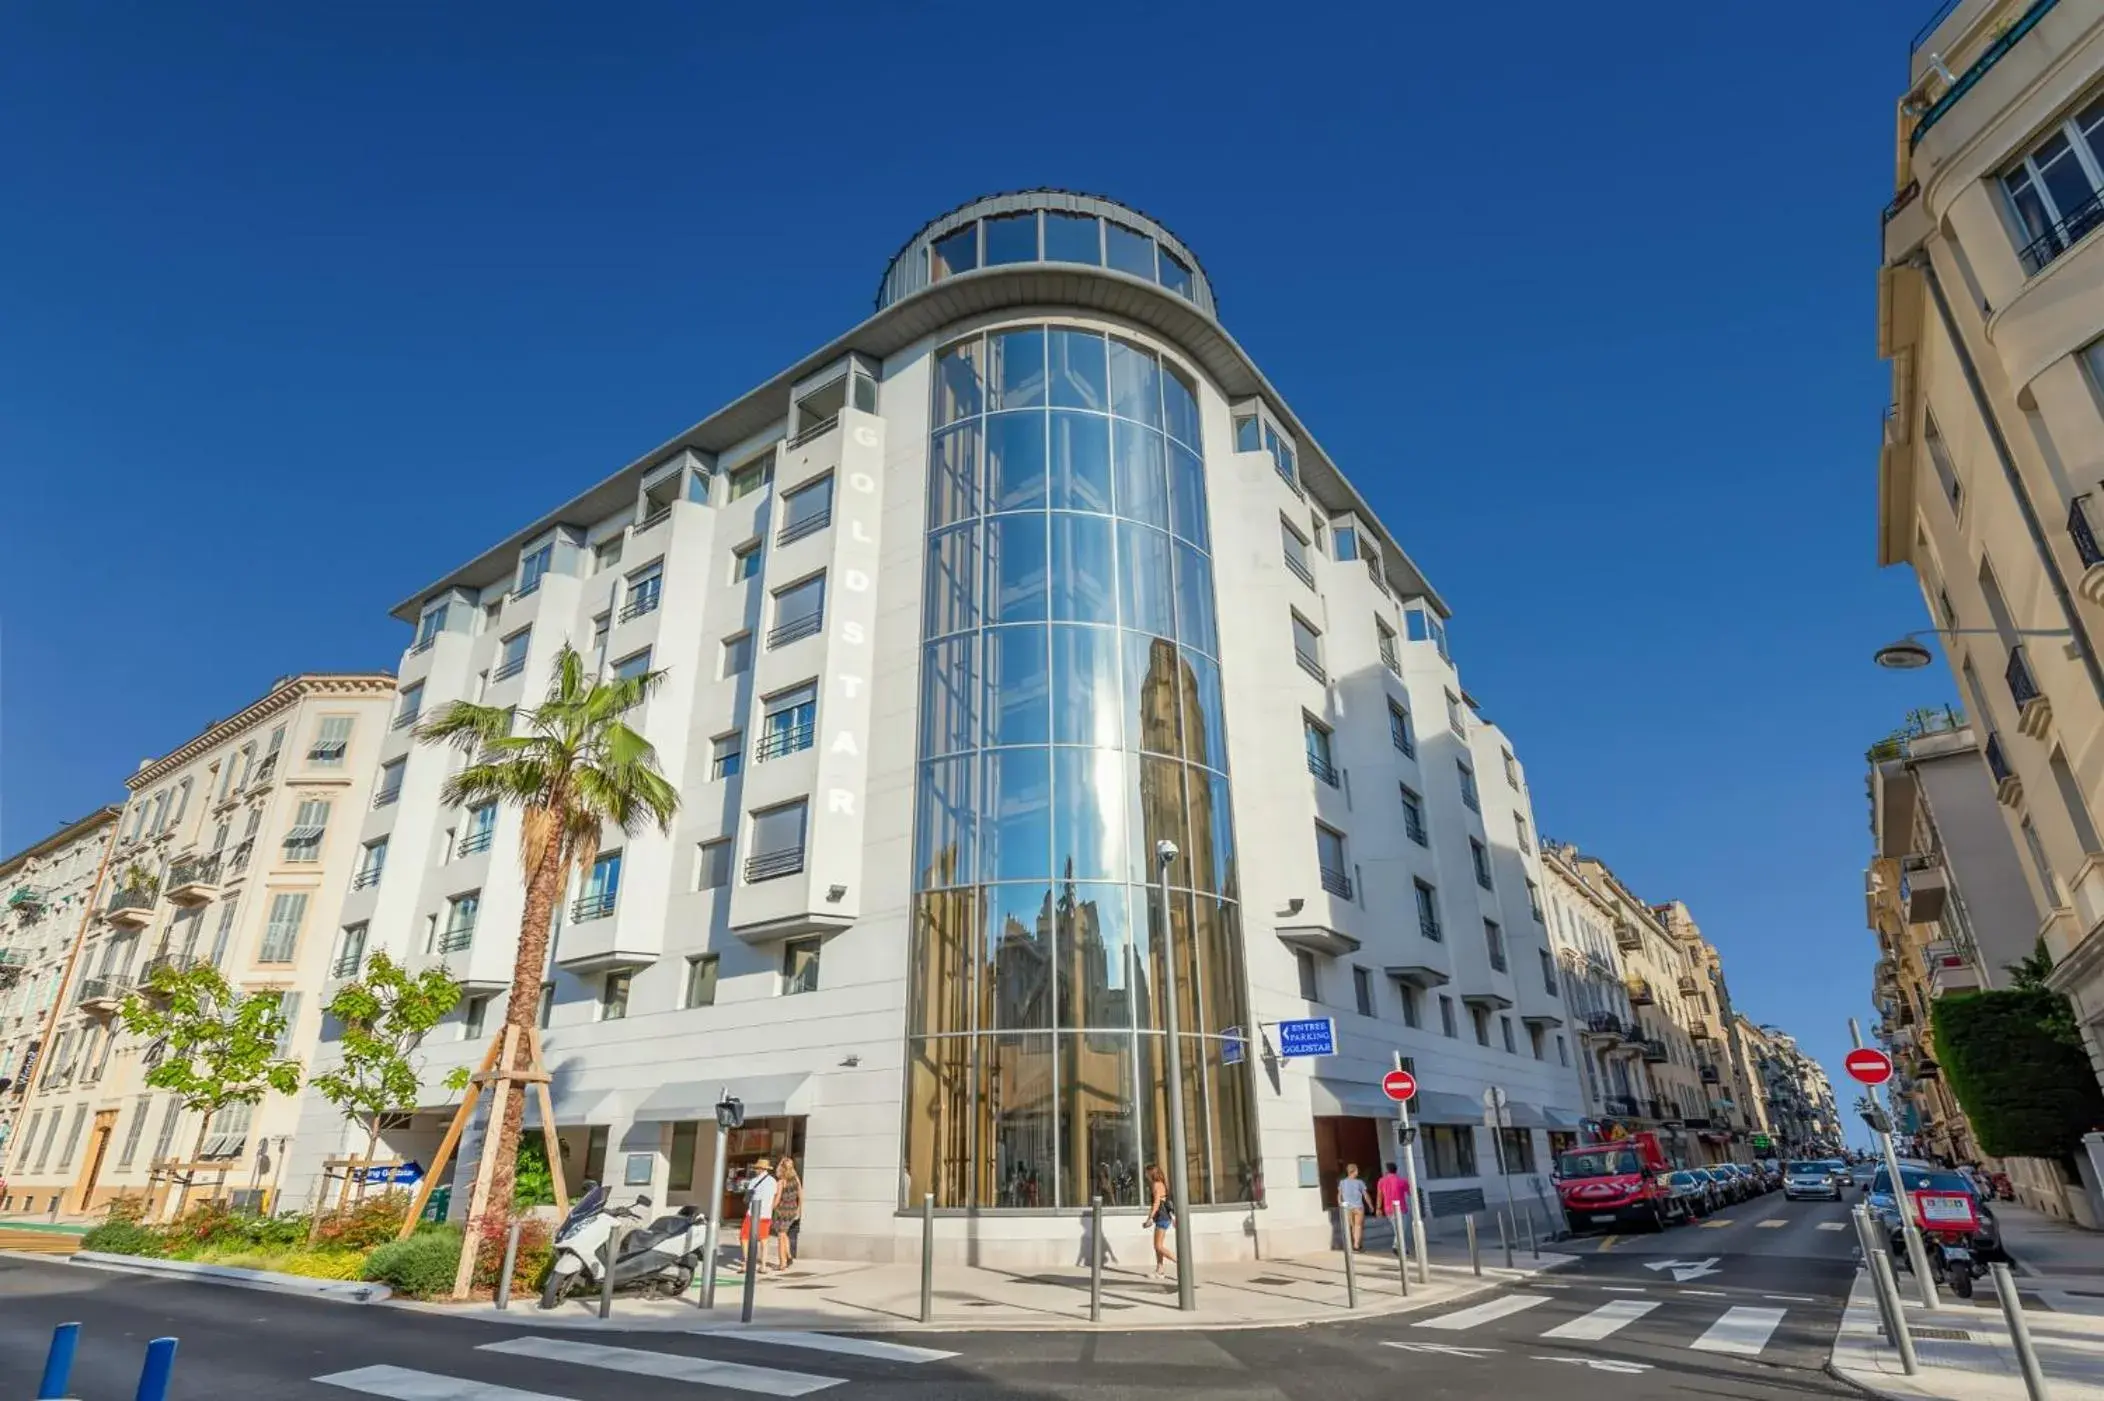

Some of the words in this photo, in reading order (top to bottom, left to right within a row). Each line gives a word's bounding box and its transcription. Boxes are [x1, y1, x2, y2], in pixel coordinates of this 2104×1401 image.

[827, 426, 879, 816] GOLDSTAR
[1290, 1032, 1330, 1041] PARKING
[1282, 1043, 1331, 1053] GOLDSTAR
